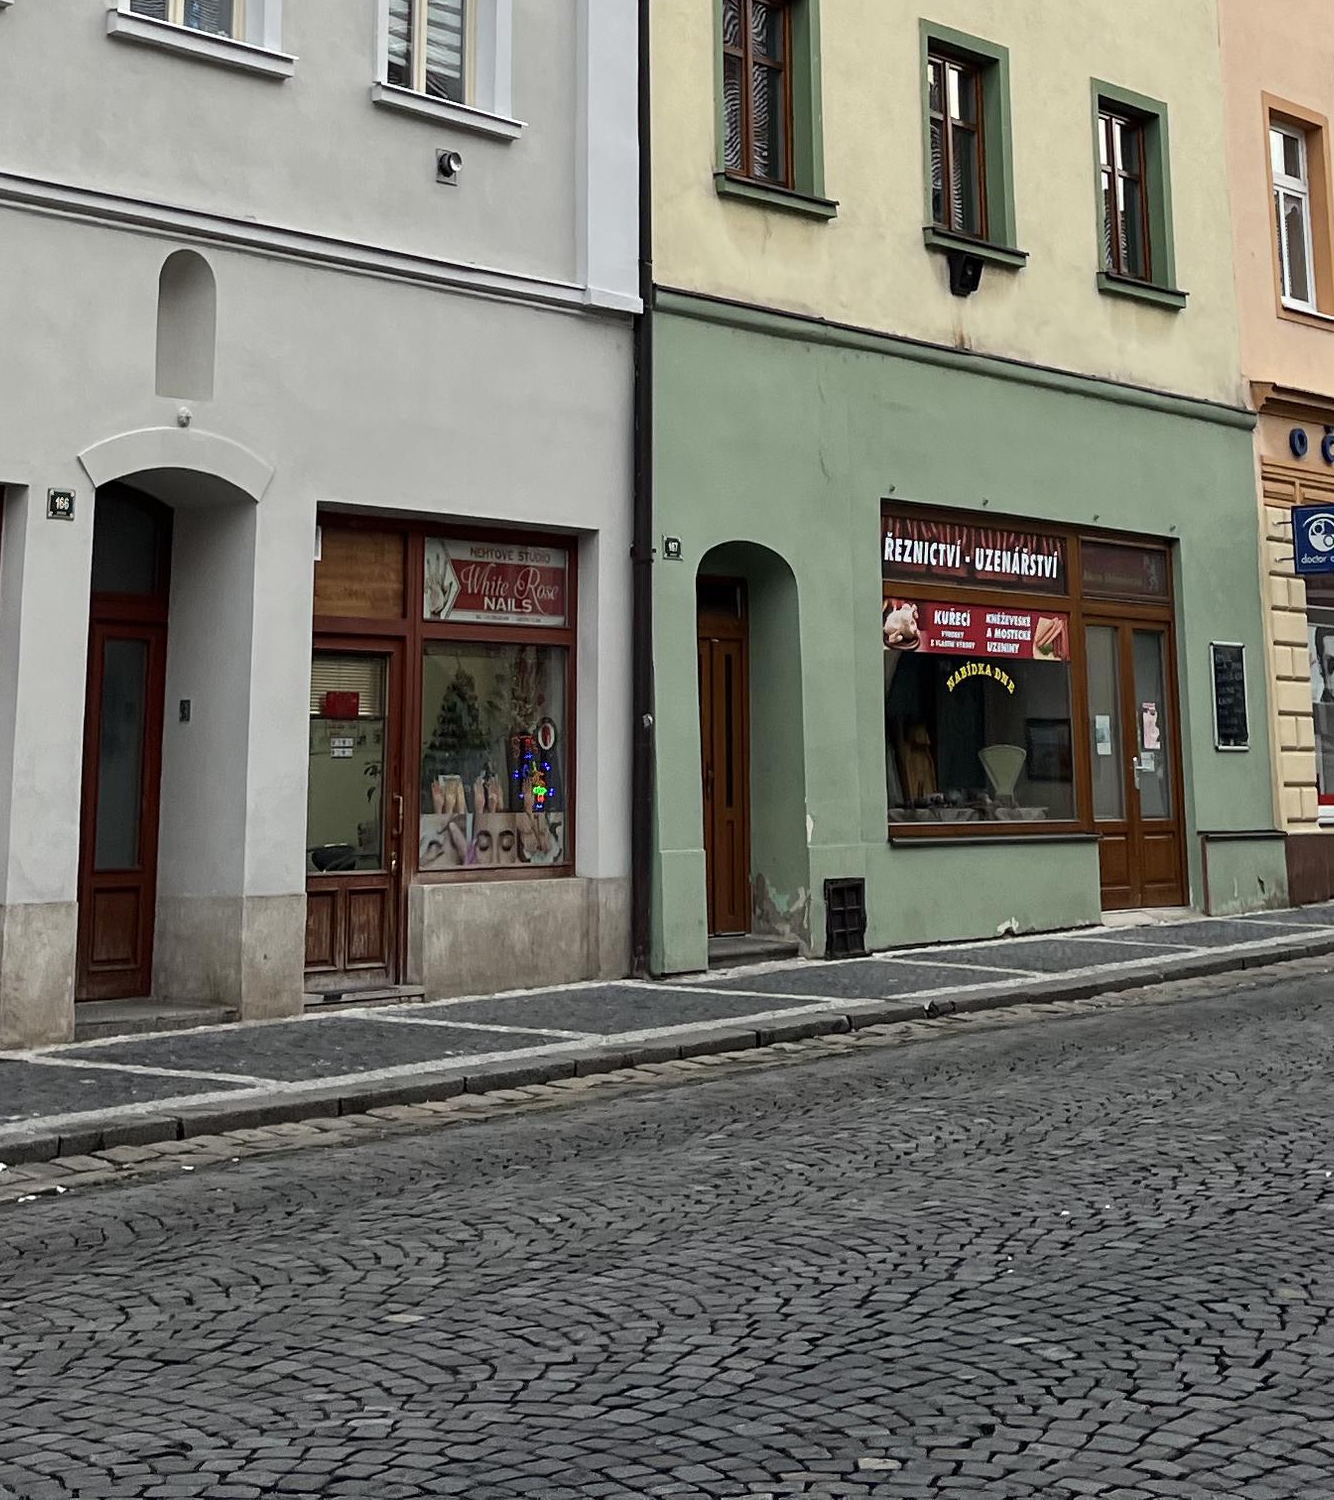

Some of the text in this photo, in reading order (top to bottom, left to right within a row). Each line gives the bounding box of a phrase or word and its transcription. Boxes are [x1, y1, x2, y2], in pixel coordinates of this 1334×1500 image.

[518, 550, 551, 564] STUDIO
[884, 532, 962, 568] ŘEZNICTVÍ
[974, 547, 1058, 579] UZENÁŘSTVÍ
[1301, 553, 1327, 565] doctor
[461, 563, 559, 615] White Rose
[484, 596, 533, 613] NAILS
[934, 608, 971, 627] KUŘECÍ
[947, 661, 1015, 694] NABÍDKA DNE
